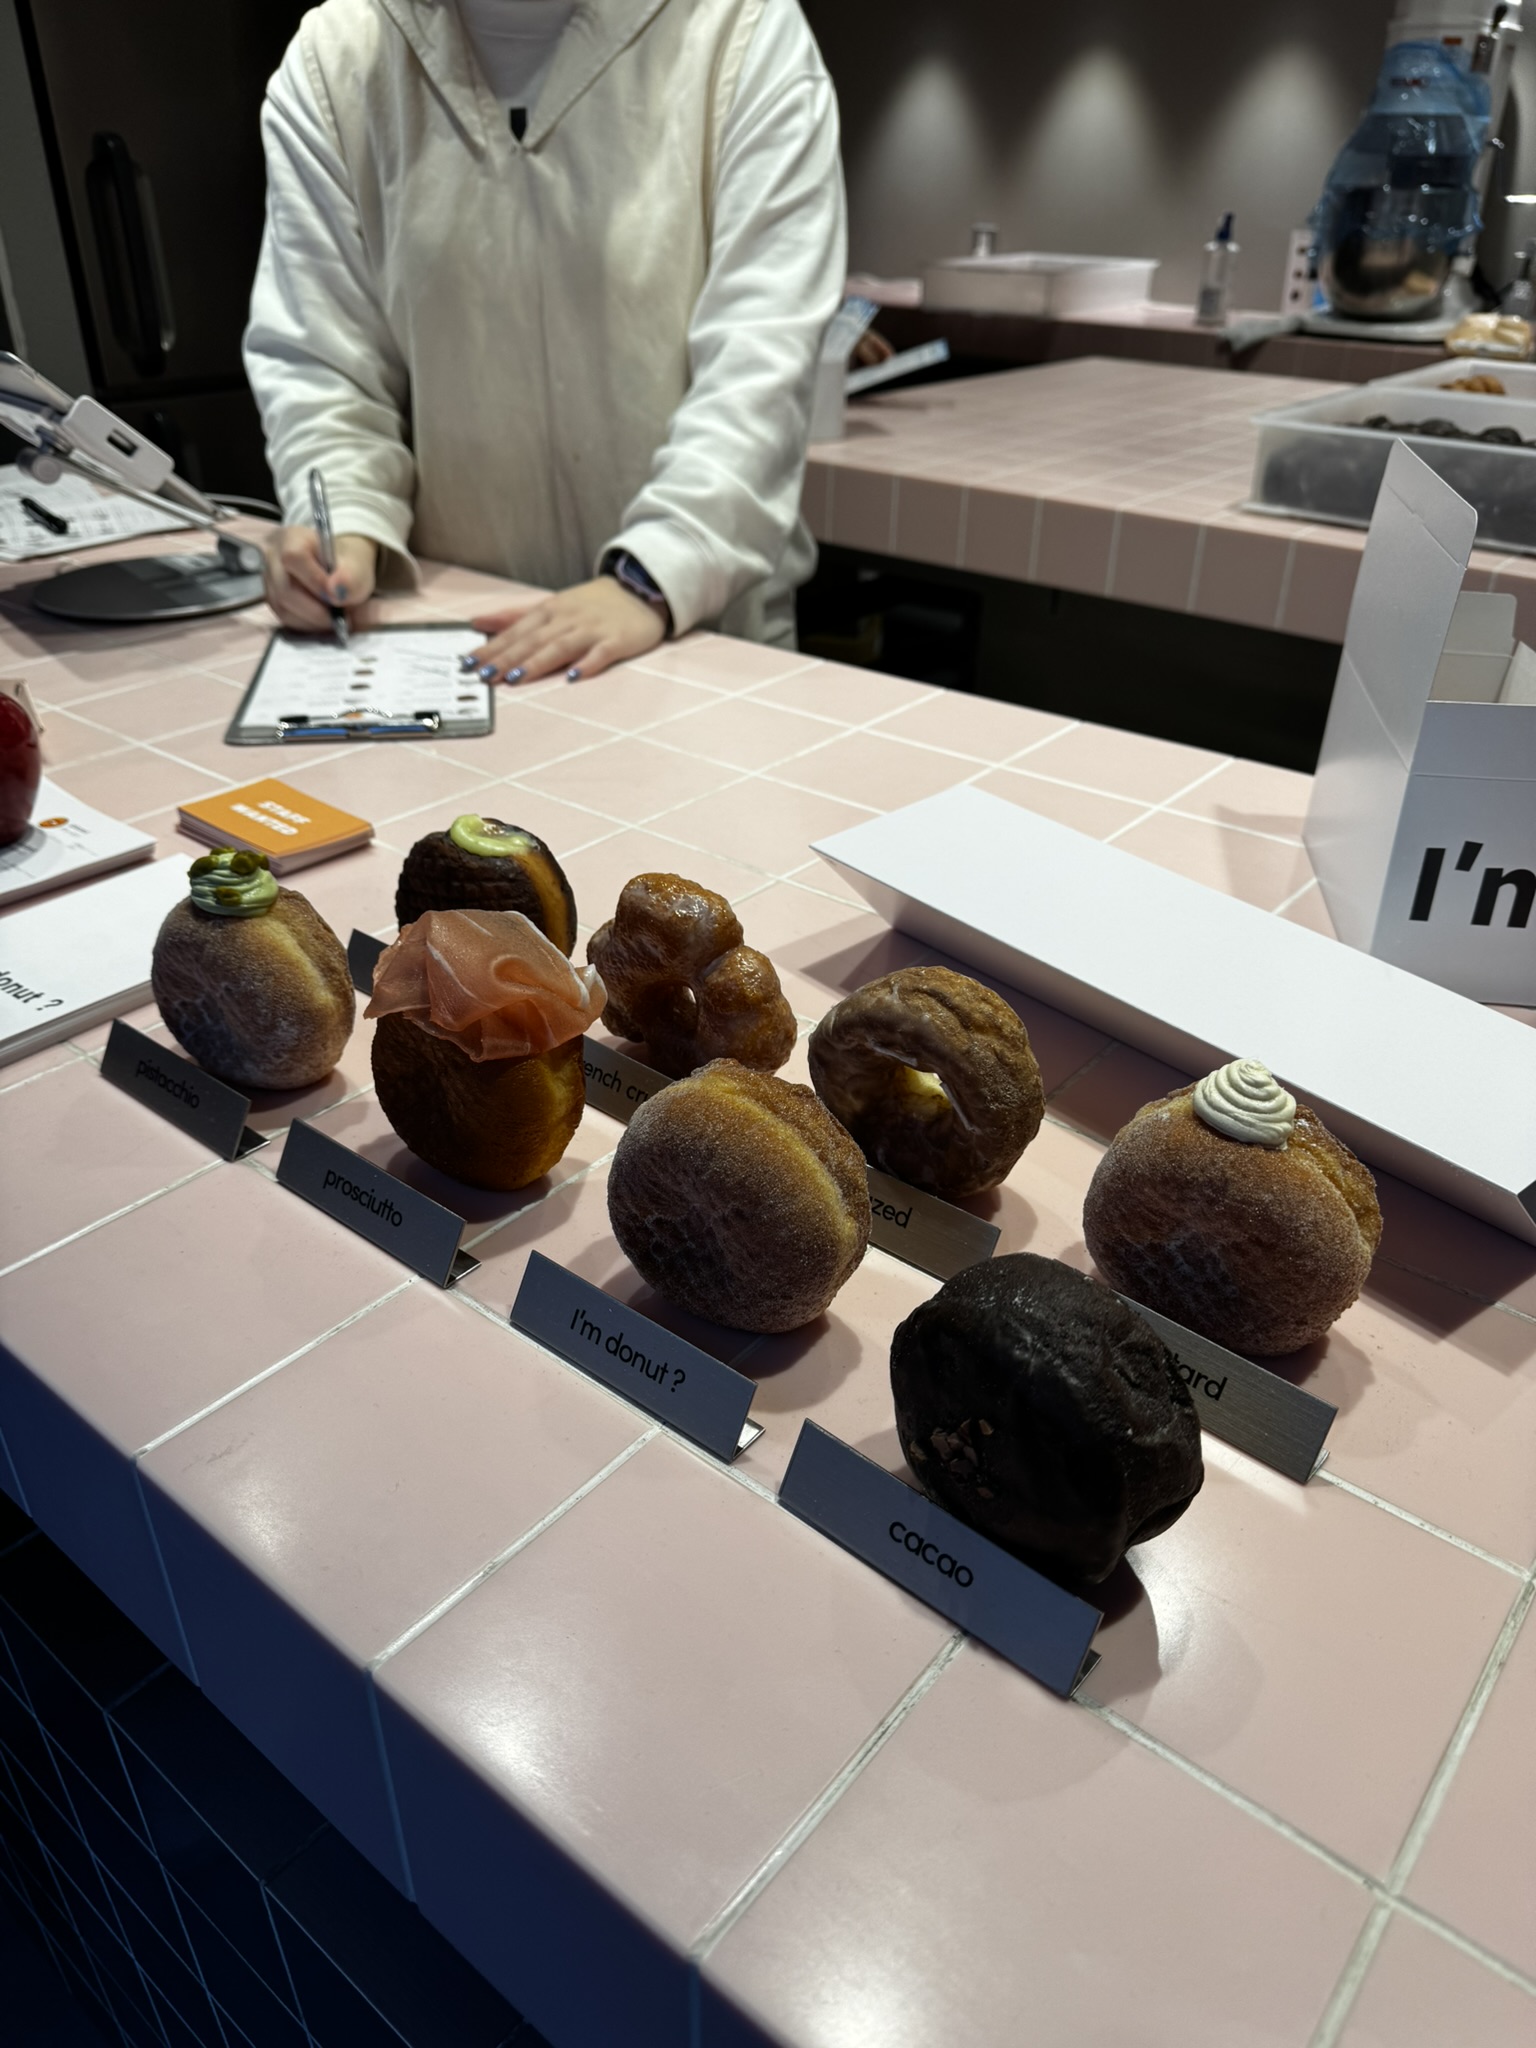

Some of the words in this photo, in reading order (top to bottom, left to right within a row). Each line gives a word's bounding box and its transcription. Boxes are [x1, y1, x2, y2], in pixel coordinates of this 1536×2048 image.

[229, 803, 299, 836] WANTED
[258, 800, 312, 824] STAFF
[135, 1060, 201, 1109] pistacchio
[583, 1060, 623, 1093] ench
[322, 1169, 403, 1228] prosciutto
[870, 1196, 913, 1229] zed
[569, 1308, 602, 1345] I'm
[889, 1521, 974, 1588] cacao
